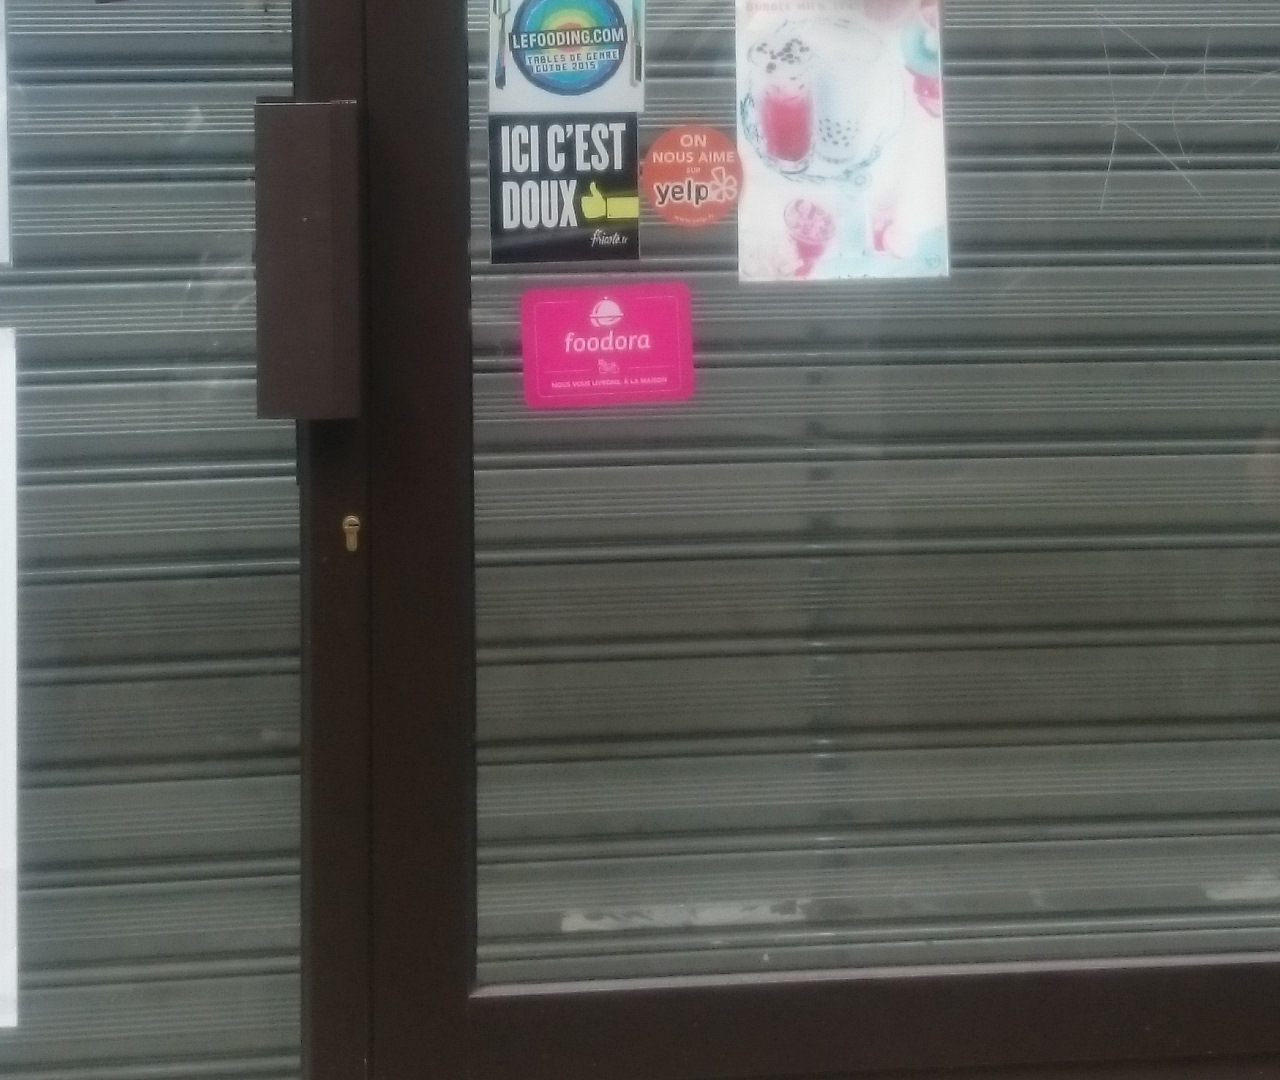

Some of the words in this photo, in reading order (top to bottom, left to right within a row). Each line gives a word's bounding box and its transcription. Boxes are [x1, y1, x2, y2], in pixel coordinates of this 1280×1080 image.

[512, 27, 625, 49] LEFOODING.COM
[527, 54, 566, 64] TABLES
[570, 53, 581, 62] DE
[586, 50, 618, 61] GENRE
[535, 62, 568, 73] GUIDE
[571, 61, 597, 71] 2015
[501, 124, 540, 173] ICI
[546, 123, 626, 172] C'EST
[680, 134, 707, 148] ON
[652, 151, 694, 164] NOUS
[698, 151, 735, 164] AIME
[686, 166, 701, 174] SUR
[655, 178, 710, 206] yelp
[501, 179, 578, 230] DOUX
[564, 329, 651, 353] foodora
[551, 381, 571, 389] NOUS
[572, 380, 591, 388] VOUS
[630, 376, 639, 385] LA
[640, 375, 668, 384] MAISON
